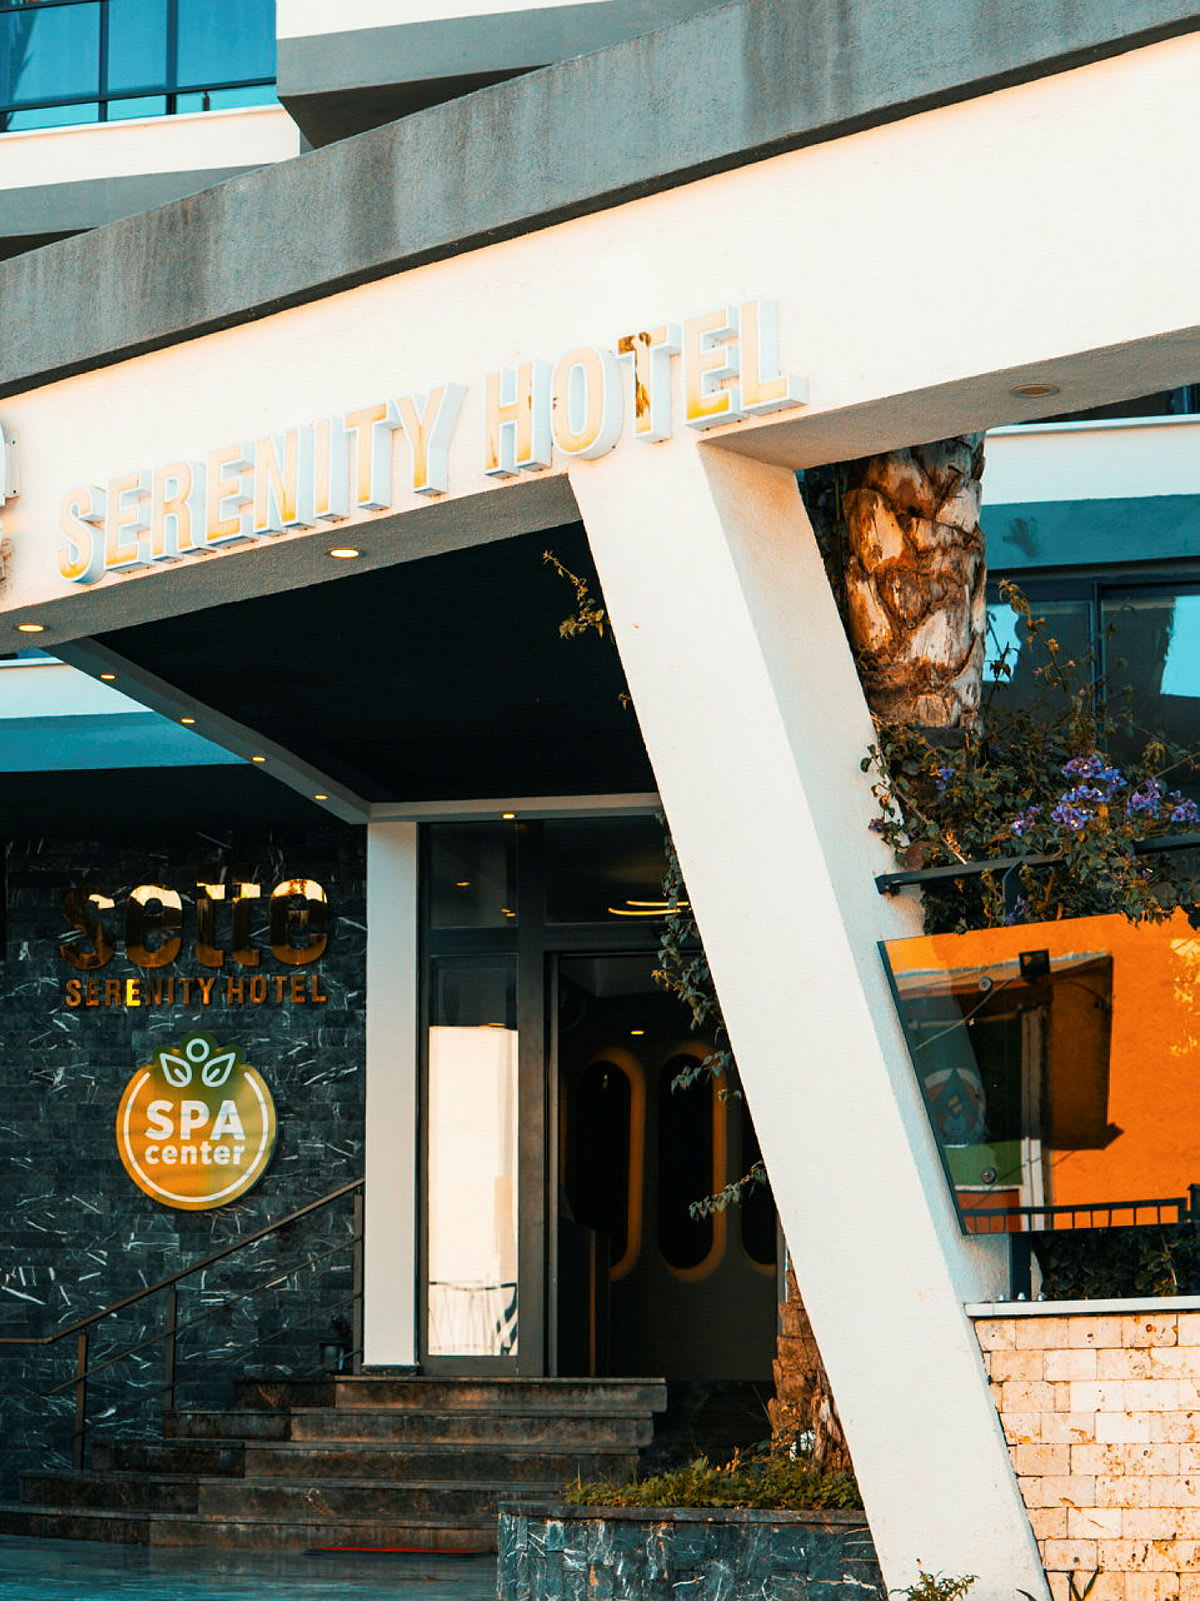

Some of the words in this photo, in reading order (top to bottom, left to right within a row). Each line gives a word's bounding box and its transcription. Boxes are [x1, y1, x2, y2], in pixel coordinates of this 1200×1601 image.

[57, 380, 467, 584] SERENITY
[484, 298, 808, 478] HOTEL
[65, 977, 216, 1007] SERENITY
[227, 974, 327, 1005] HOTEL
[145, 1100, 246, 1141] SPA
[145, 1141, 246, 1165] center
